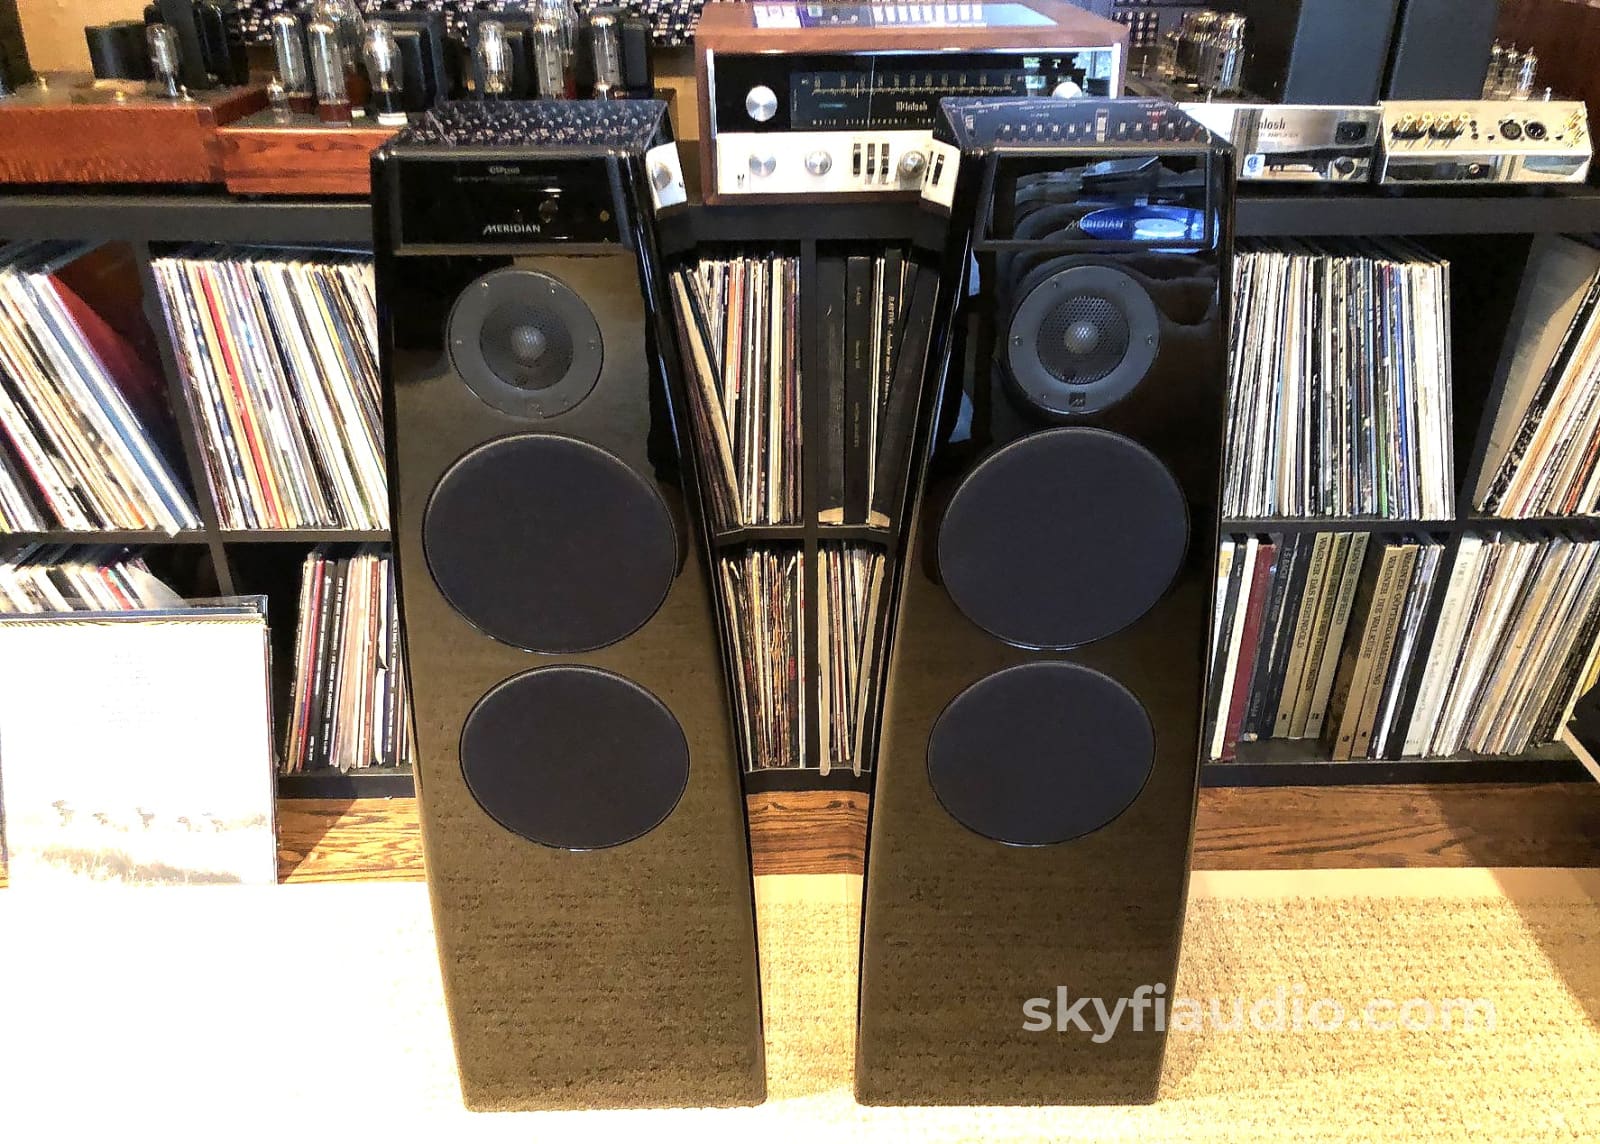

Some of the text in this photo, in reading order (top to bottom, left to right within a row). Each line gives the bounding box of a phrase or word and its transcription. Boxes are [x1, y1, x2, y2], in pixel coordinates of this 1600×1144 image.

[482, 223, 541, 235] MERIDIAN
[1064, 219, 1124, 232] MERIDIAN
[1381, 556, 1396, 594] WAGNER
